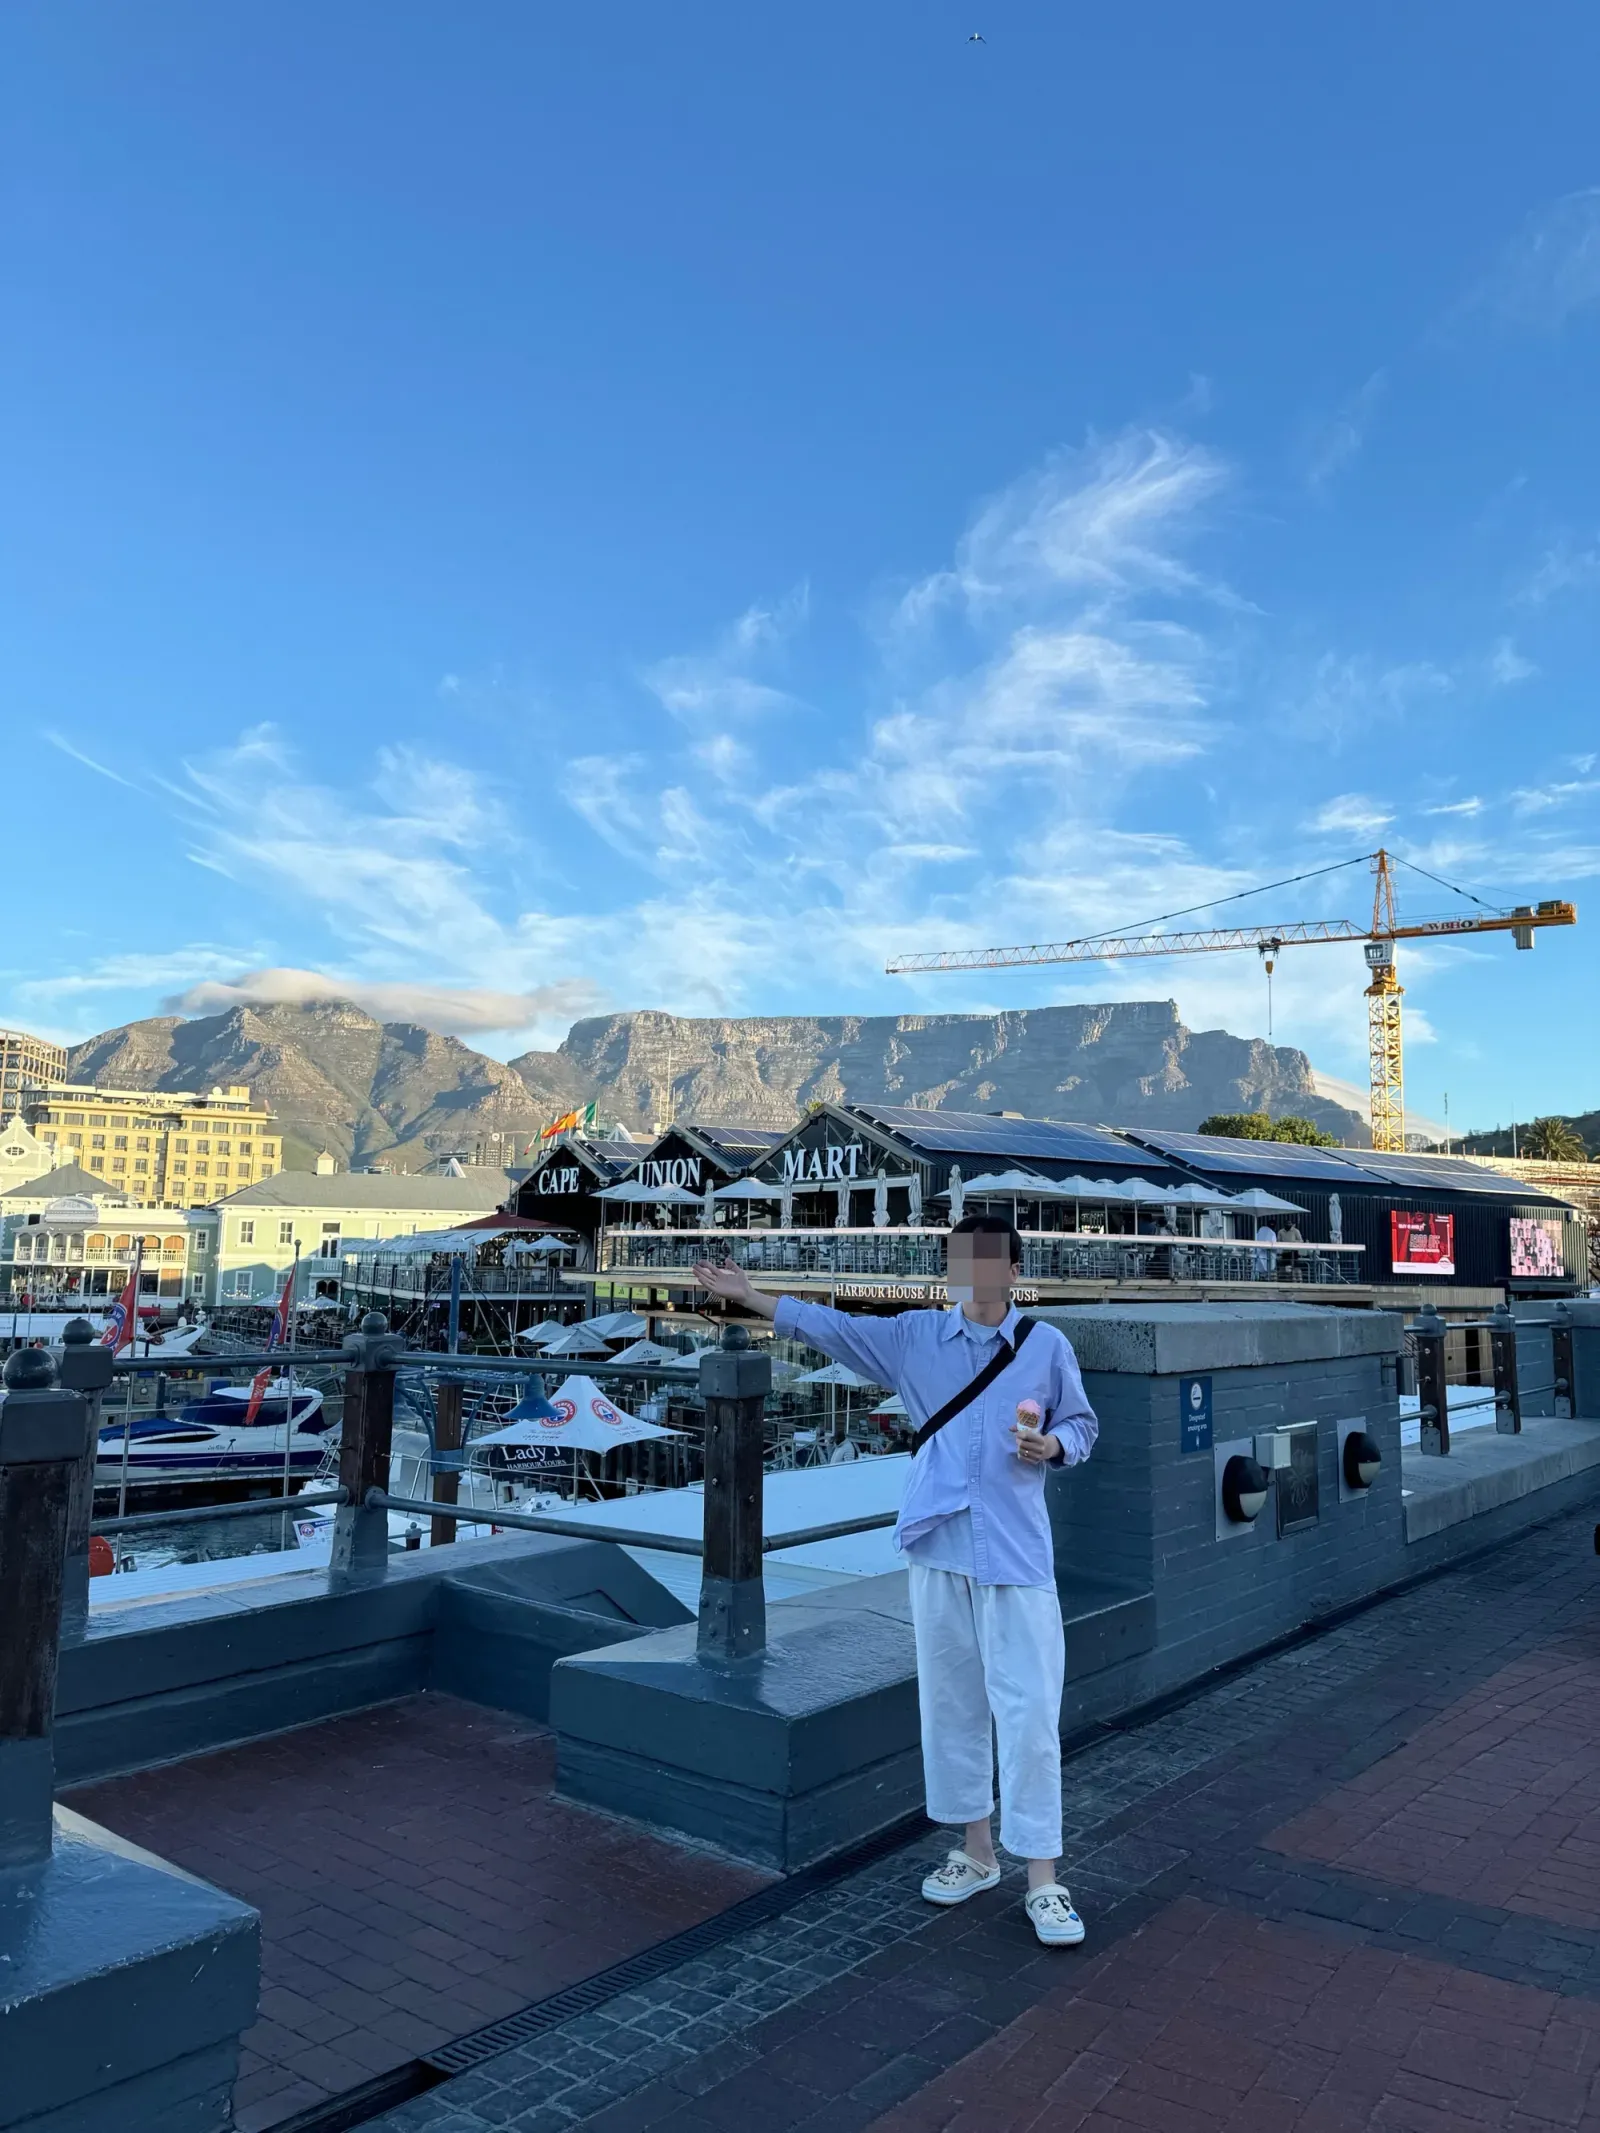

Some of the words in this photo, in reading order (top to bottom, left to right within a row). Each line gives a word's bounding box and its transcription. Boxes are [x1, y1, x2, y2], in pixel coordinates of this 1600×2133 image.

[1428, 920, 1473, 931] WBHO
[538, 1167, 579, 1195] CAPE
[638, 1157, 702, 1189] UNION
[782, 1144, 863, 1181] MART
[836, 1283, 885, 1298] HARBOUR
[887, 1285, 925, 1299] HOUSE
[1009, 1287, 1038, 1302] OUSE
[501, 1446, 546, 1461] Lady
[506, 1461, 542, 1470] HARBOUR
[543, 1459, 567, 1467] TOURS
